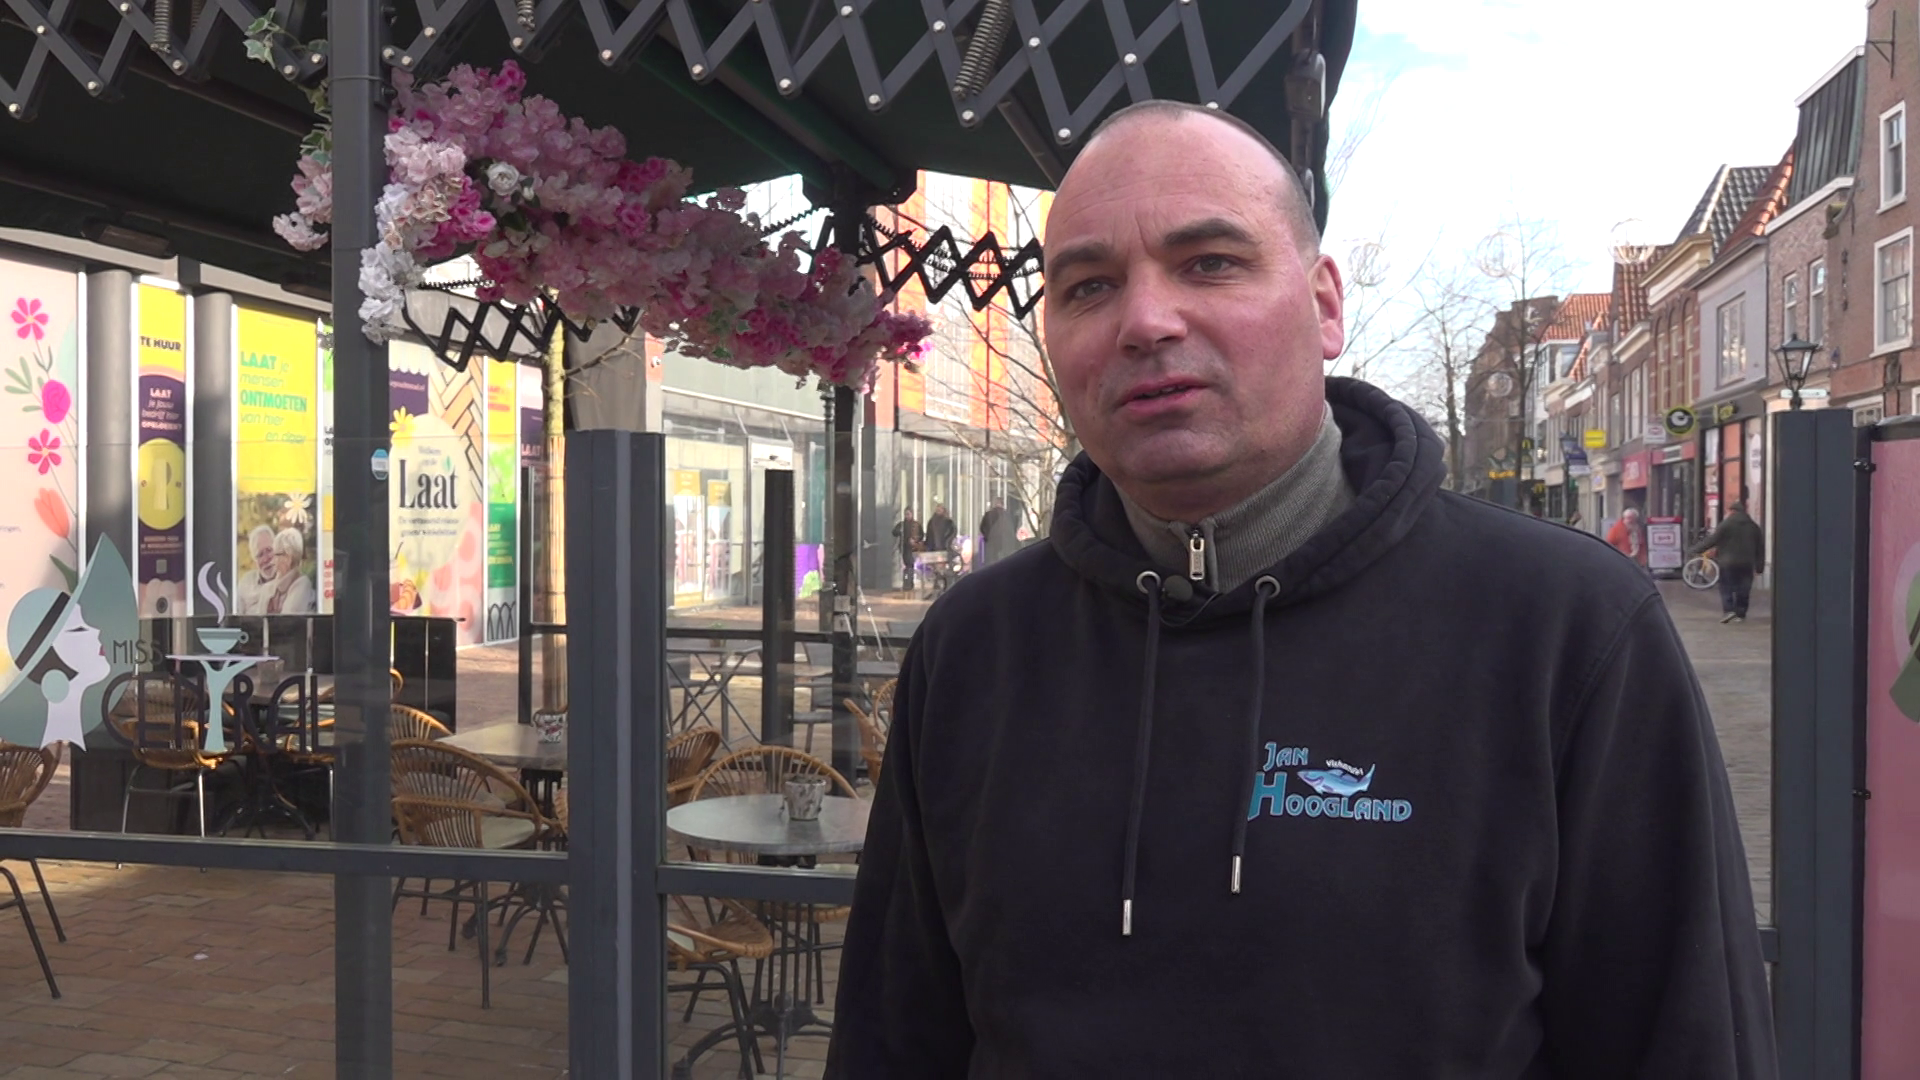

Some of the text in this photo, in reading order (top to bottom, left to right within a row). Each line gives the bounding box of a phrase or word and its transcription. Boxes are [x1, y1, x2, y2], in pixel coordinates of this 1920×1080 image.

[140, 336, 182, 351] TE HUUR
[241, 351, 277, 370] LAAT
[240, 374, 284, 388] mensen
[149, 387, 172, 399] LAAT
[240, 389, 308, 412] ONTMOETEN
[240, 412, 284, 426] van hier
[266, 431, 279, 442] en
[399, 460, 458, 509] Laat
[113, 639, 164, 664] MISS
[1262, 741, 1309, 772] JAN
[1247, 771, 1412, 822] HOOGLAND
